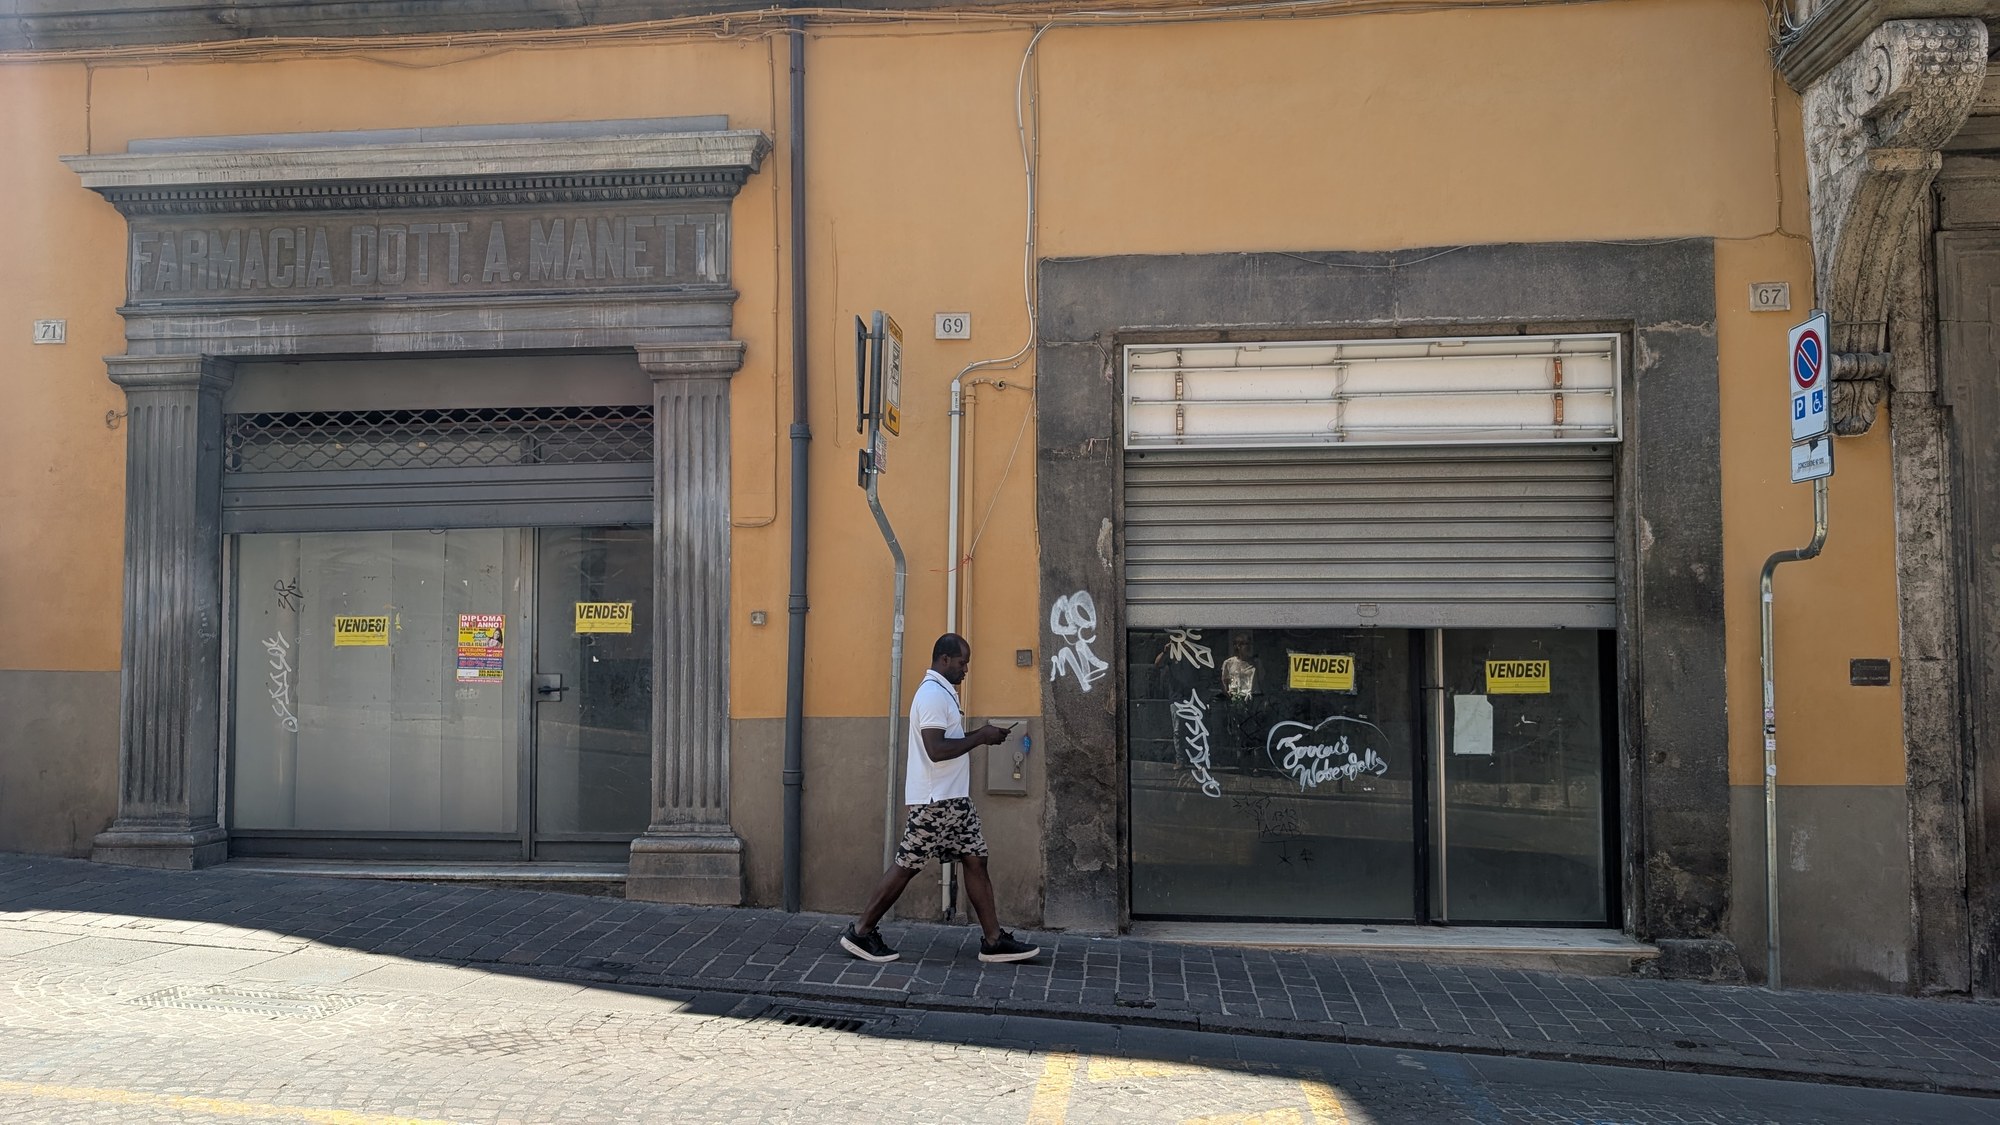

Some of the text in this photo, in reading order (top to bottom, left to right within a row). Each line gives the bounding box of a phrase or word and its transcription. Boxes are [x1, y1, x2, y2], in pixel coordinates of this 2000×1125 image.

[133, 225, 334, 295] FARMACIA
[350, 221, 474, 287] DOTT.
[482, 220, 523, 284] A.
[1759, 288, 1782, 305] 67
[42, 325, 56, 338] 71
[942, 317, 964, 334] 69
[1795, 402, 1804, 418] P
[576, 604, 630, 620] VENDESI
[337, 618, 386, 633] VENDESI
[1293, 656, 1350, 674] VENDESI
[1488, 662, 1547, 679] VENDESI
